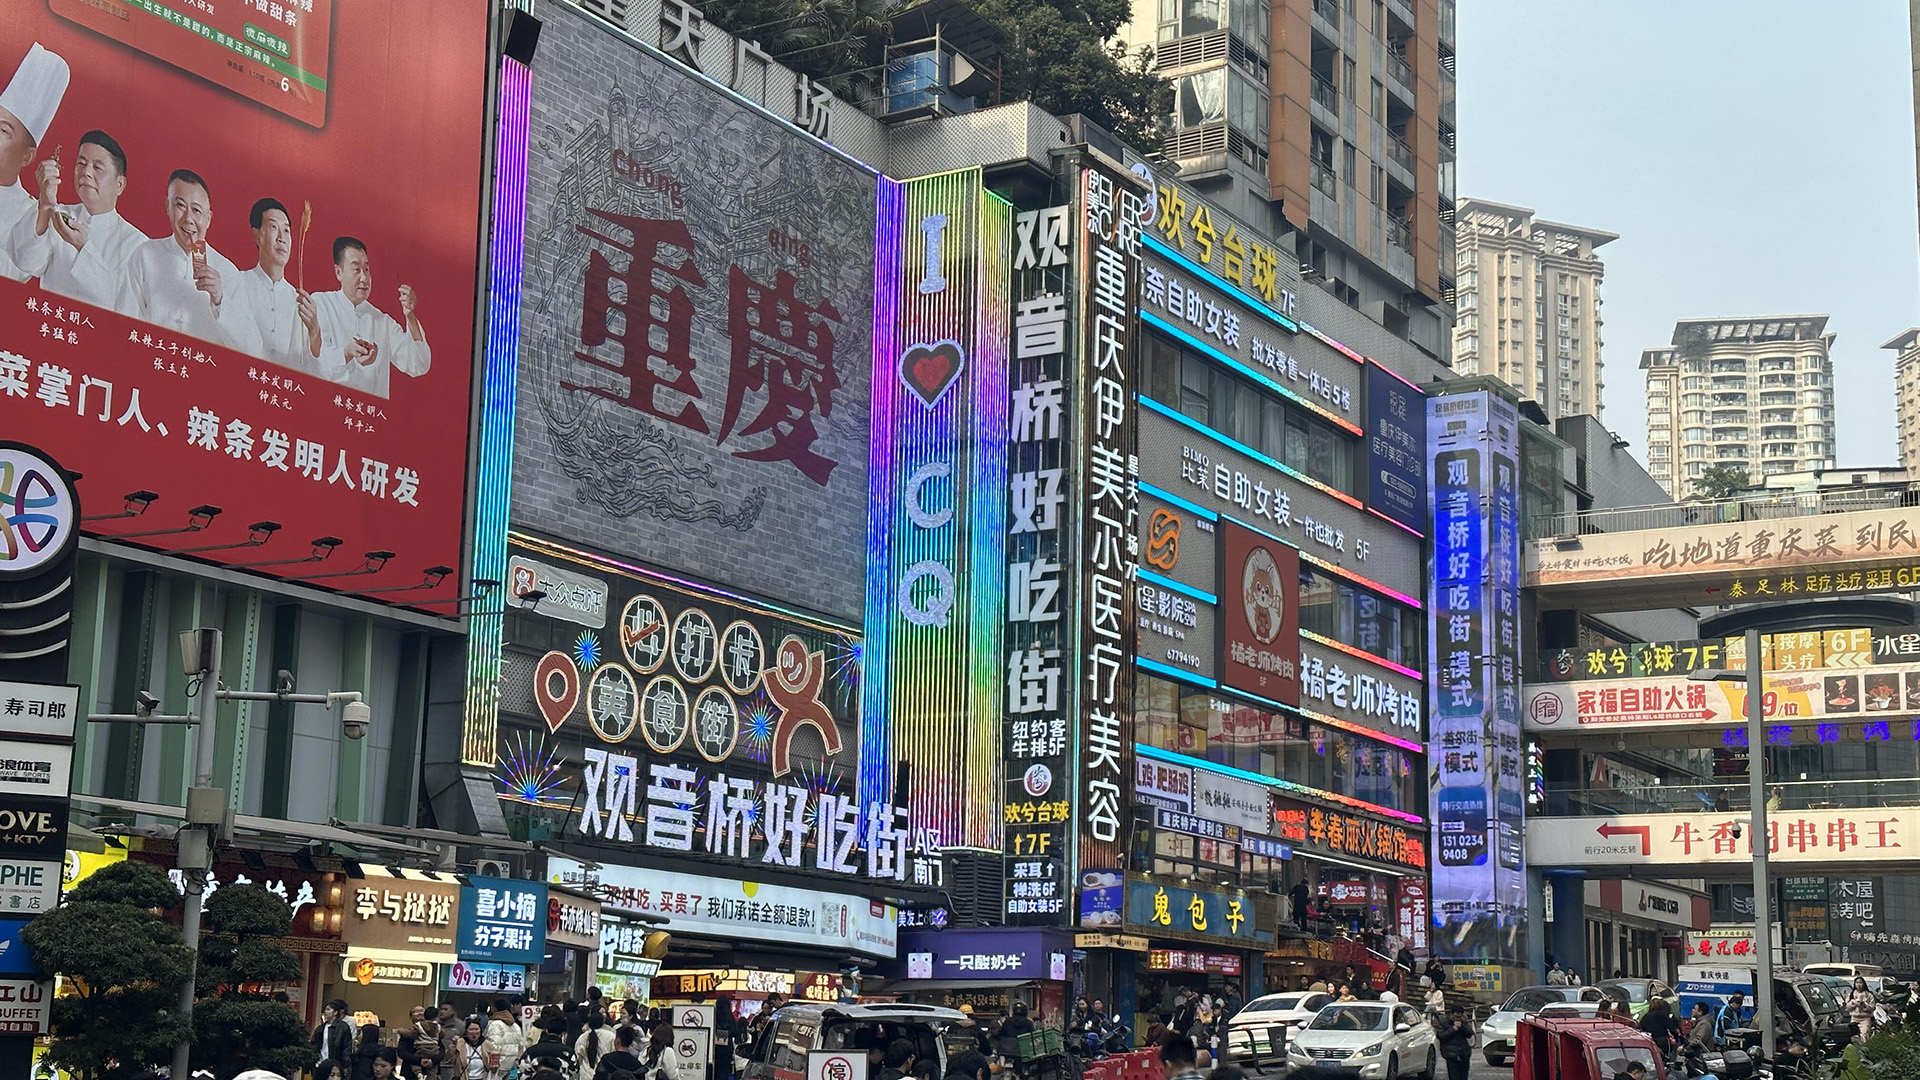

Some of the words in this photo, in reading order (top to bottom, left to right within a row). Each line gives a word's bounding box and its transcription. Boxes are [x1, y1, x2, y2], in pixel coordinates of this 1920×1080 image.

[244, 26, 289, 55] 微麻微辣
[613, 148, 684, 208] Chong
[1087, 169, 1100, 234] 伊美尔
[768, 227, 811, 268] qing
[920, 214, 948, 294] I
[1158, 184, 1279, 302] 欢兮台球
[1280, 288, 1296, 316] 7F
[26, 297, 95, 331] 辣条发明人
[1141, 263, 1240, 349] 奈自助女装
[128, 329, 217, 368] 麻辣王子创始人
[247, 367, 306, 396] 辣条发明人
[259, 389, 293, 411] 钟庆元
[333, 394, 388, 421] 辣条发明人
[1380, 418, 1416, 453] 重庆伊美尔
[1007, 204, 1070, 714] 观音桥好吃街
[1183, 446, 1209, 467] BIMO
[1214, 463, 1291, 528] 自助女装
[1294, 514, 1345, 553] 一件也批发
[1356, 538, 1370, 561] 5F
[1088, 244, 1127, 842] 重庆伊美尔医疗美容
[1642, 523, 1843, 569] 吃地道重庆菜
[539, 576, 602, 614] 大众点评
[1447, 458, 1472, 708] 观音桥好吃街模式
[1498, 463, 1515, 714] 观音桥好吃街模式
[1806, 574, 1832, 592] 足疗
[1836, 572, 1862, 590] 头疗
[1866, 569, 1893, 586] 采耳
[1184, 600, 1197, 614] SPA
[624, 608, 754, 676] 必打卡
[1779, 633, 1815, 650] 按摩
[1831, 630, 1867, 652] 6F
[1166, 649, 1200, 667] 67794190
[1230, 640, 1294, 681] 橘老师烤肉
[1781, 653, 1816, 671] 头疗
[1300, 652, 1420, 733] 橘老师烤肉
[1577, 685, 1707, 714] 家福自助火锅
[1743, 691, 1799, 717] 9/位
[4, 697, 67, 720] 寿司郎
[598, 677, 728, 744] 美食街
[1012, 718, 1066, 739] 纽约客
[1012, 737, 1066, 758] 牛排5F
[1445, 751, 1478, 774] 模式
[579, 747, 908, 881] 观音桥好吃街
[1005, 801, 1070, 824] 欢兮台球
[1162, 811, 1223, 838] 重庆特产便利店
[14, 834, 46, 845] KTV
[914, 828, 941, 855] A区
[1026, 833, 1051, 854] 7F
[1258, 839, 1283, 858] 便利店
[1309, 808, 1407, 864] 李春丽火锅馆
[1442, 835, 1457, 847] 131
[1459, 834, 1484, 846] 0234
[1585, 846, 1637, 855] 前行20米左转
[1443, 849, 1468, 860] 9408
[0, 865, 44, 886] PHE
[914, 857, 943, 887] 南门
[1014, 863, 1042, 878] 采耳
[356, 886, 450, 925] 李与挞挞
[476, 888, 537, 922] 喜小摘
[1151, 886, 1245, 934] 鬼包子
[474, 925, 533, 951] 分子果汁
[1400, 908, 1412, 940] 新鲜
[1413, 899, 1426, 948] 无限量
[944, 955, 1022, 971] 一只酸奶牛
[1700, 970, 1730, 980] 重庆快递
[1686, 983, 1699, 991] ZTO
